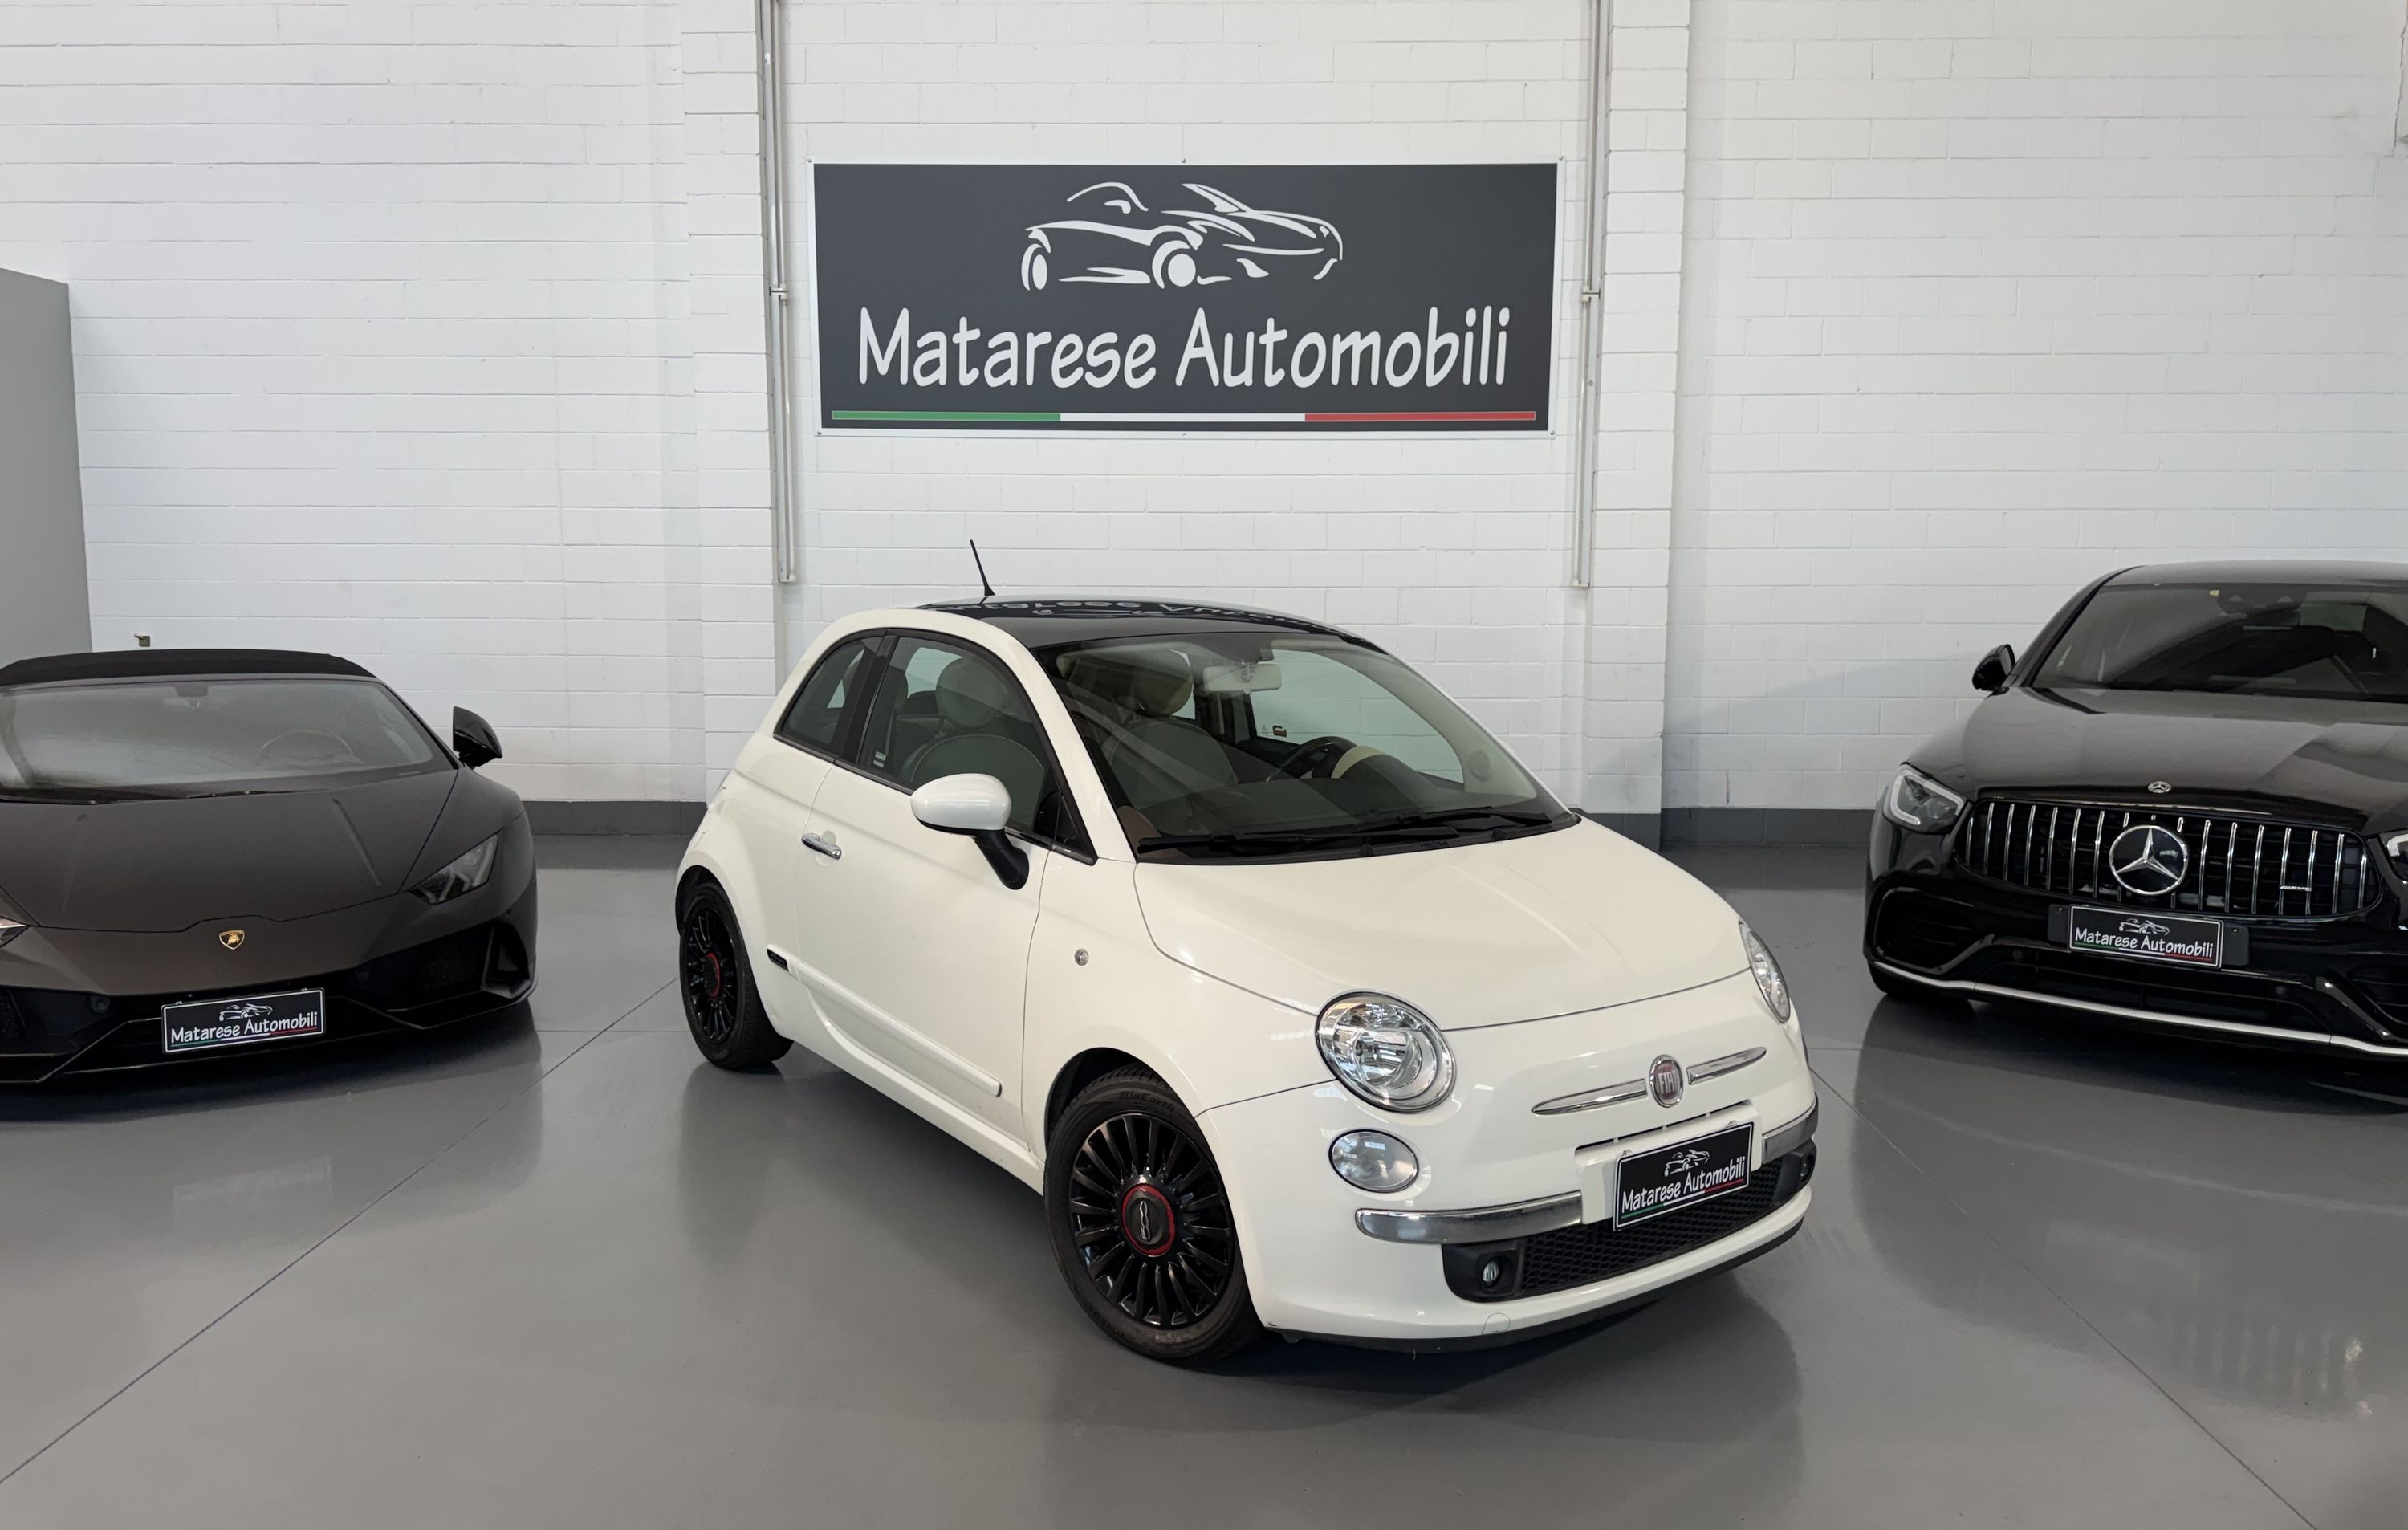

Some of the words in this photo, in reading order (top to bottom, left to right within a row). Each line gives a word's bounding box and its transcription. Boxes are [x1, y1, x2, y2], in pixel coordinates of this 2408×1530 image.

[858, 307, 1157, 388] Matarese
[1174, 305, 1511, 389] Automobili
[2075, 926, 2138, 949] Matarese
[2140, 935, 2214, 958] Automobili
[170, 1023, 241, 1044] Matarese
[243, 1011, 318, 1035] Automobili
[1658, 1070, 1678, 1095] FIAT
[1621, 1181, 1682, 1214] Matarese
[1683, 1156, 1746, 1192] Automobili
